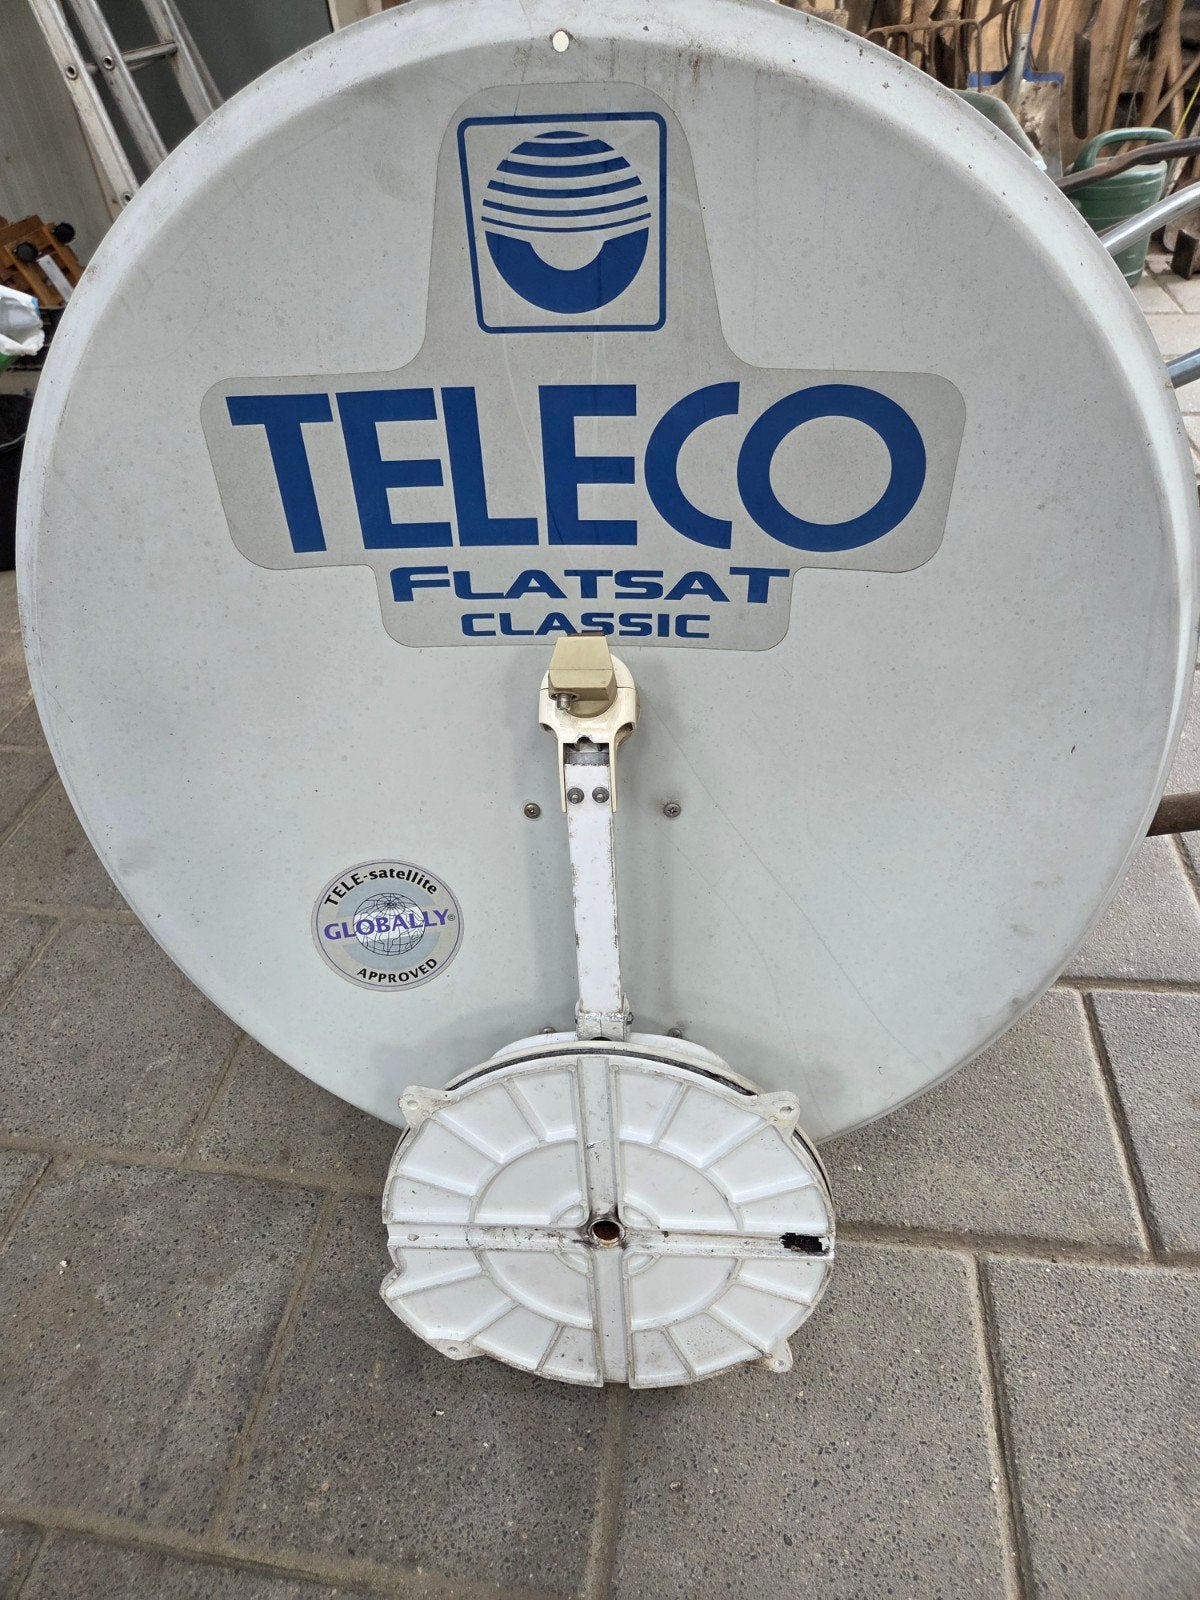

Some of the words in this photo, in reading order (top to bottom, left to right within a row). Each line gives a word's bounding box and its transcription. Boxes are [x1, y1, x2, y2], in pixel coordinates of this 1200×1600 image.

[227, 381, 926, 553] TELECO
[389, 565, 790, 603] FLATSAT
[460, 611, 710, 638] CLASSIC
[324, 868, 437, 906] TELE-satellite
[356, 957, 437, 983] APPROVED
